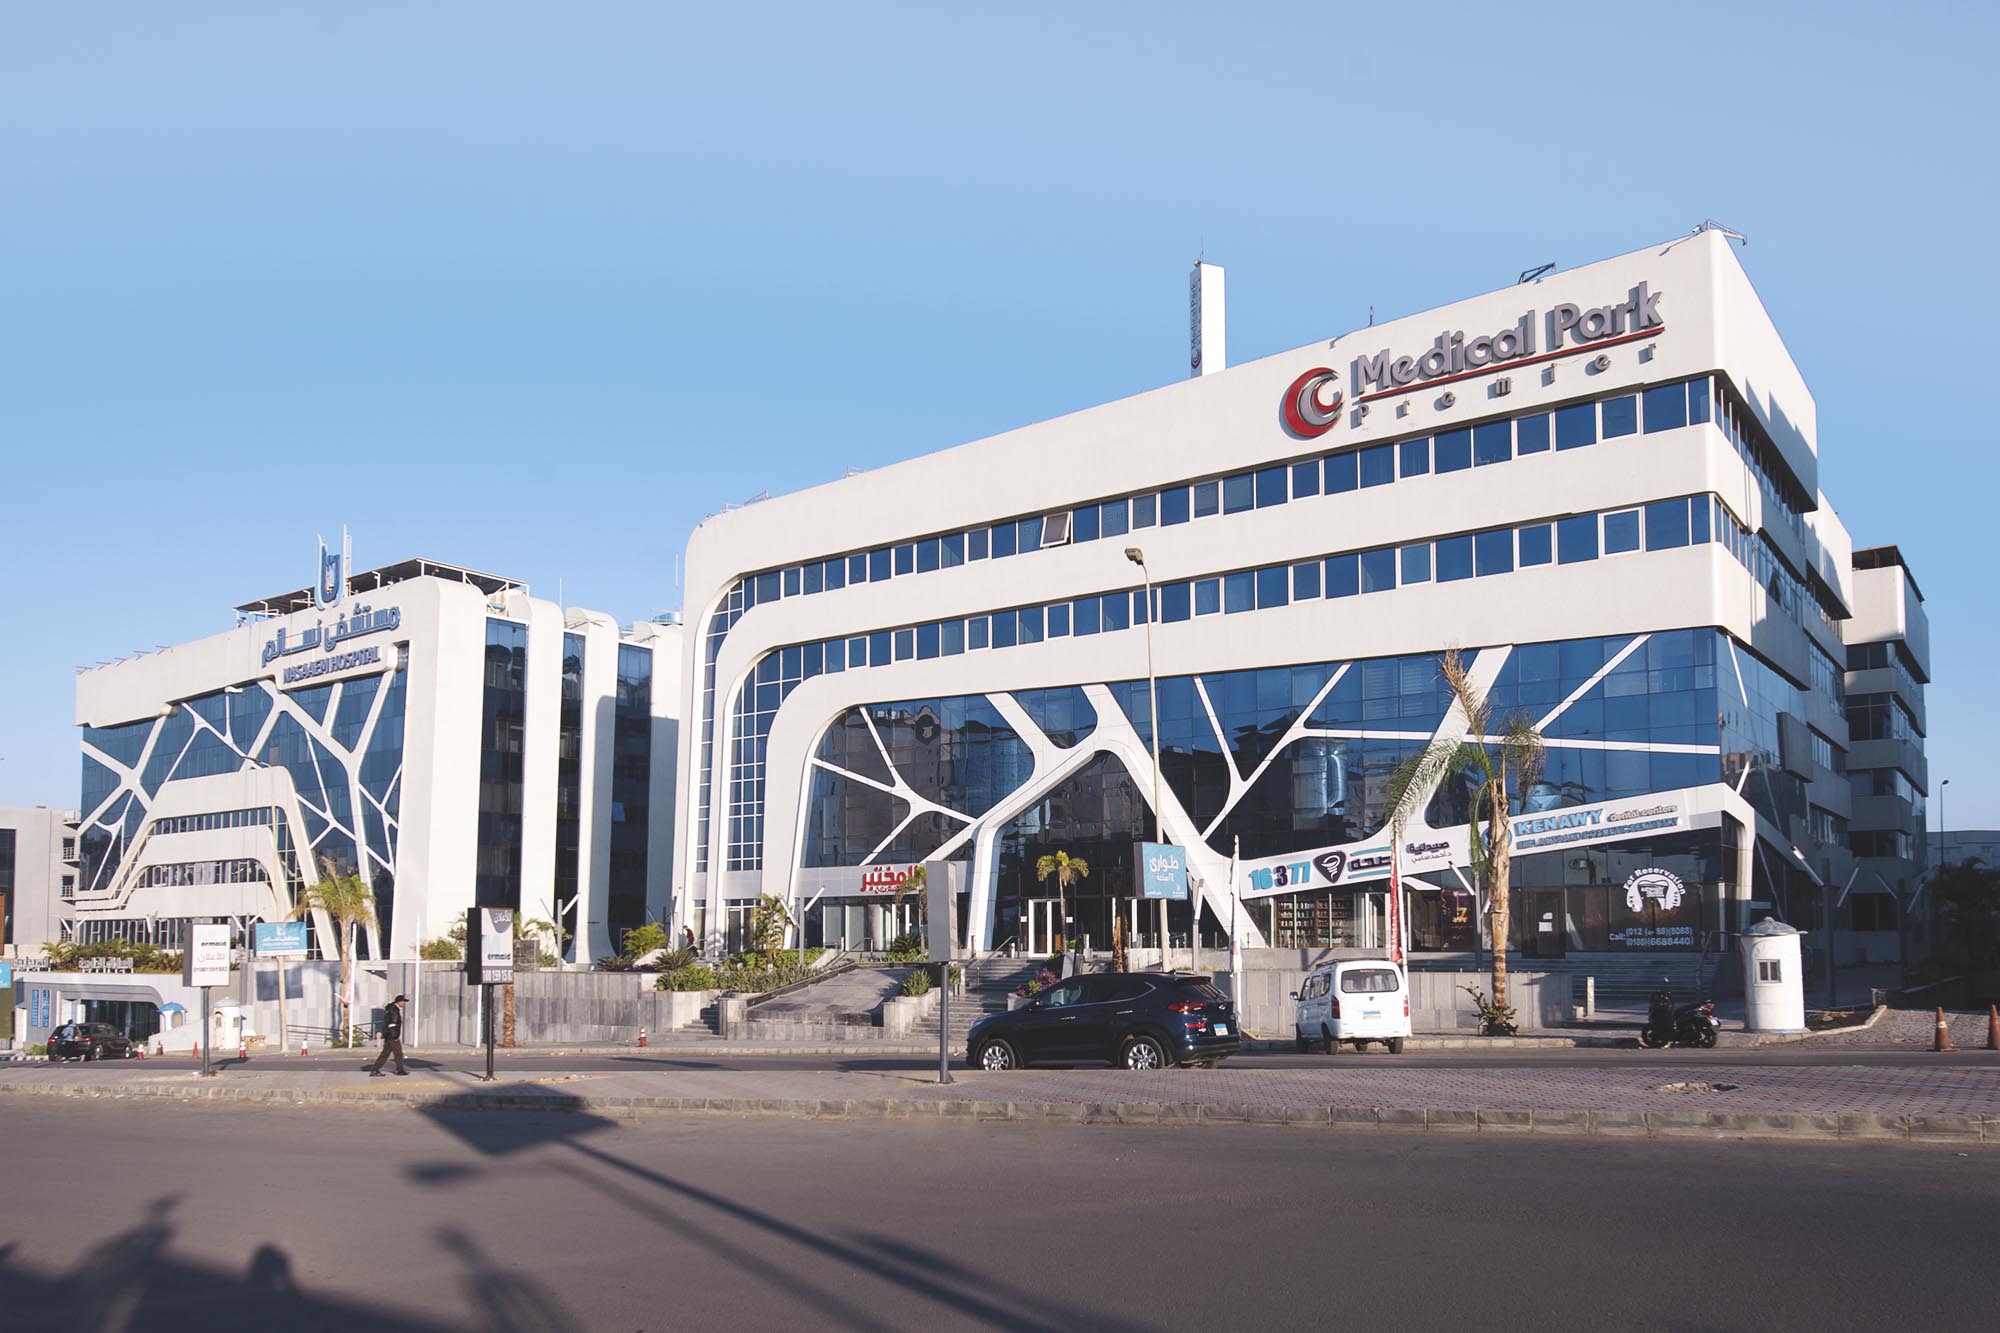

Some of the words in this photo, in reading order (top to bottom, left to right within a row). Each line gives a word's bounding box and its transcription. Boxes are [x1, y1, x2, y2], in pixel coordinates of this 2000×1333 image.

[1351, 310, 1537, 397] Medical
[1546, 280, 1662, 349] Park
[1351, 343, 1657, 429] Premier
[331, 645, 381, 672] HOSPITAL
[1514, 808, 1604, 837] KENAWY
[860, 865, 921, 893] لمختبر
[1248, 860, 1311, 891] 16377
[1623, 875, 1635, 890] For
[1634, 867, 1687, 895] Reservation
